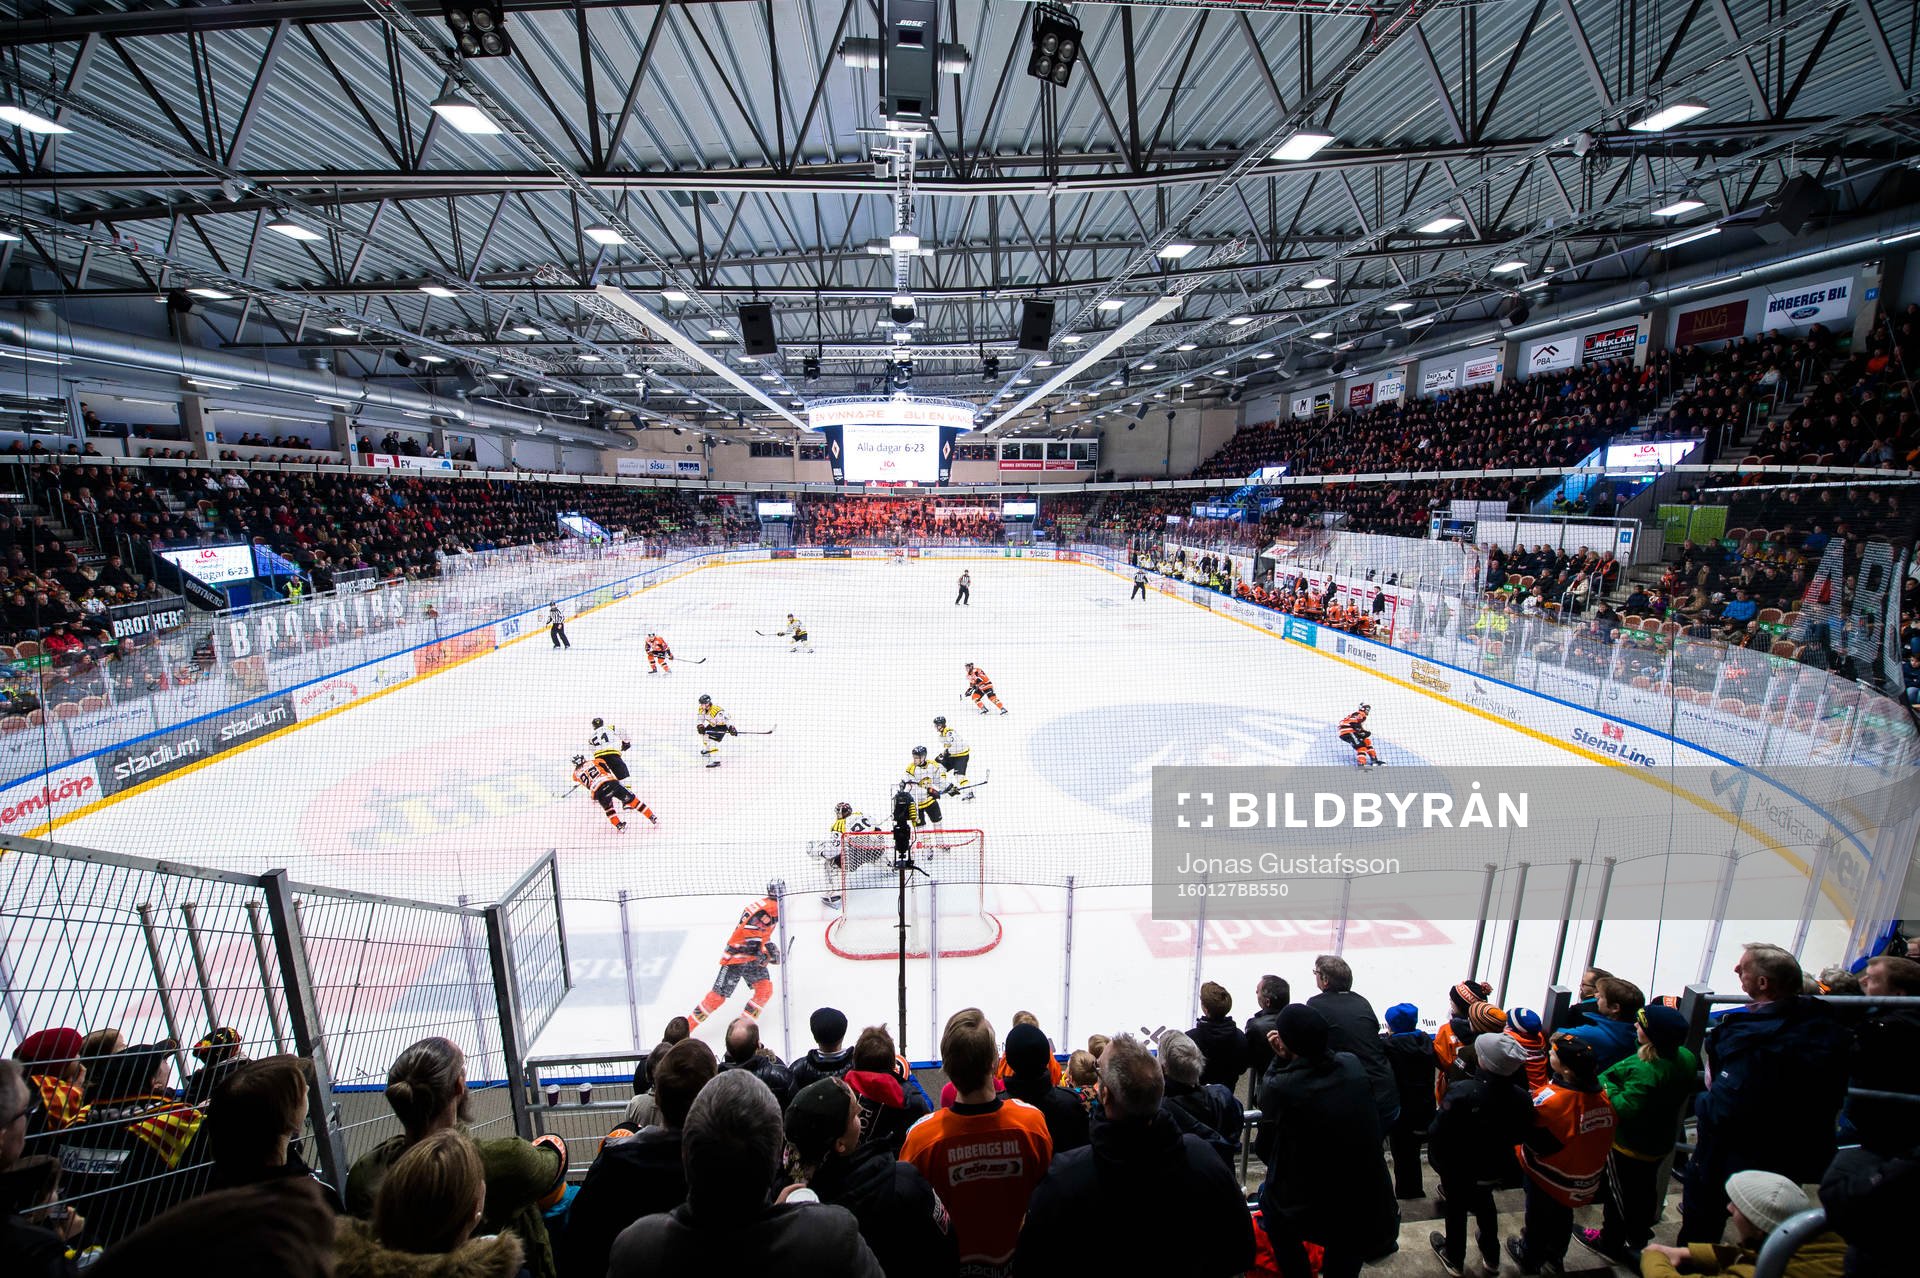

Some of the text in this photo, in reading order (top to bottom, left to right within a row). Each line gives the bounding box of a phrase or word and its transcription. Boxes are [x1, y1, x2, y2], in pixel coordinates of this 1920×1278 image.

[899, 19, 924, 27] BOSE
[1768, 286, 1848, 313] RÅBERGS BIL
[1595, 335, 1635, 349] REKLAM
[1536, 356, 1551, 366] PBA
[827, 409, 886, 420] VINNARE
[904, 411, 926, 420] BLI
[929, 412, 945, 421] EN
[857, 442, 926, 455] Alla dagar 6-23
[1641, 445, 1656, 454] ICA
[200, 550, 217, 559] ICA
[228, 567, 250, 577] 6-23
[185, 579, 224, 609] BROTHERS
[112, 608, 186, 639] BROTHERS
[1347, 644, 1377, 663] Roxtec
[221, 705, 287, 741] stadium
[1572, 727, 1657, 768] Stena Line
[113, 735, 200, 781] stadium
[579, 765, 600, 790] 92
[0, 775, 94, 828] emköp
[948, 1140, 1021, 1163] RÅBERGS BIL
